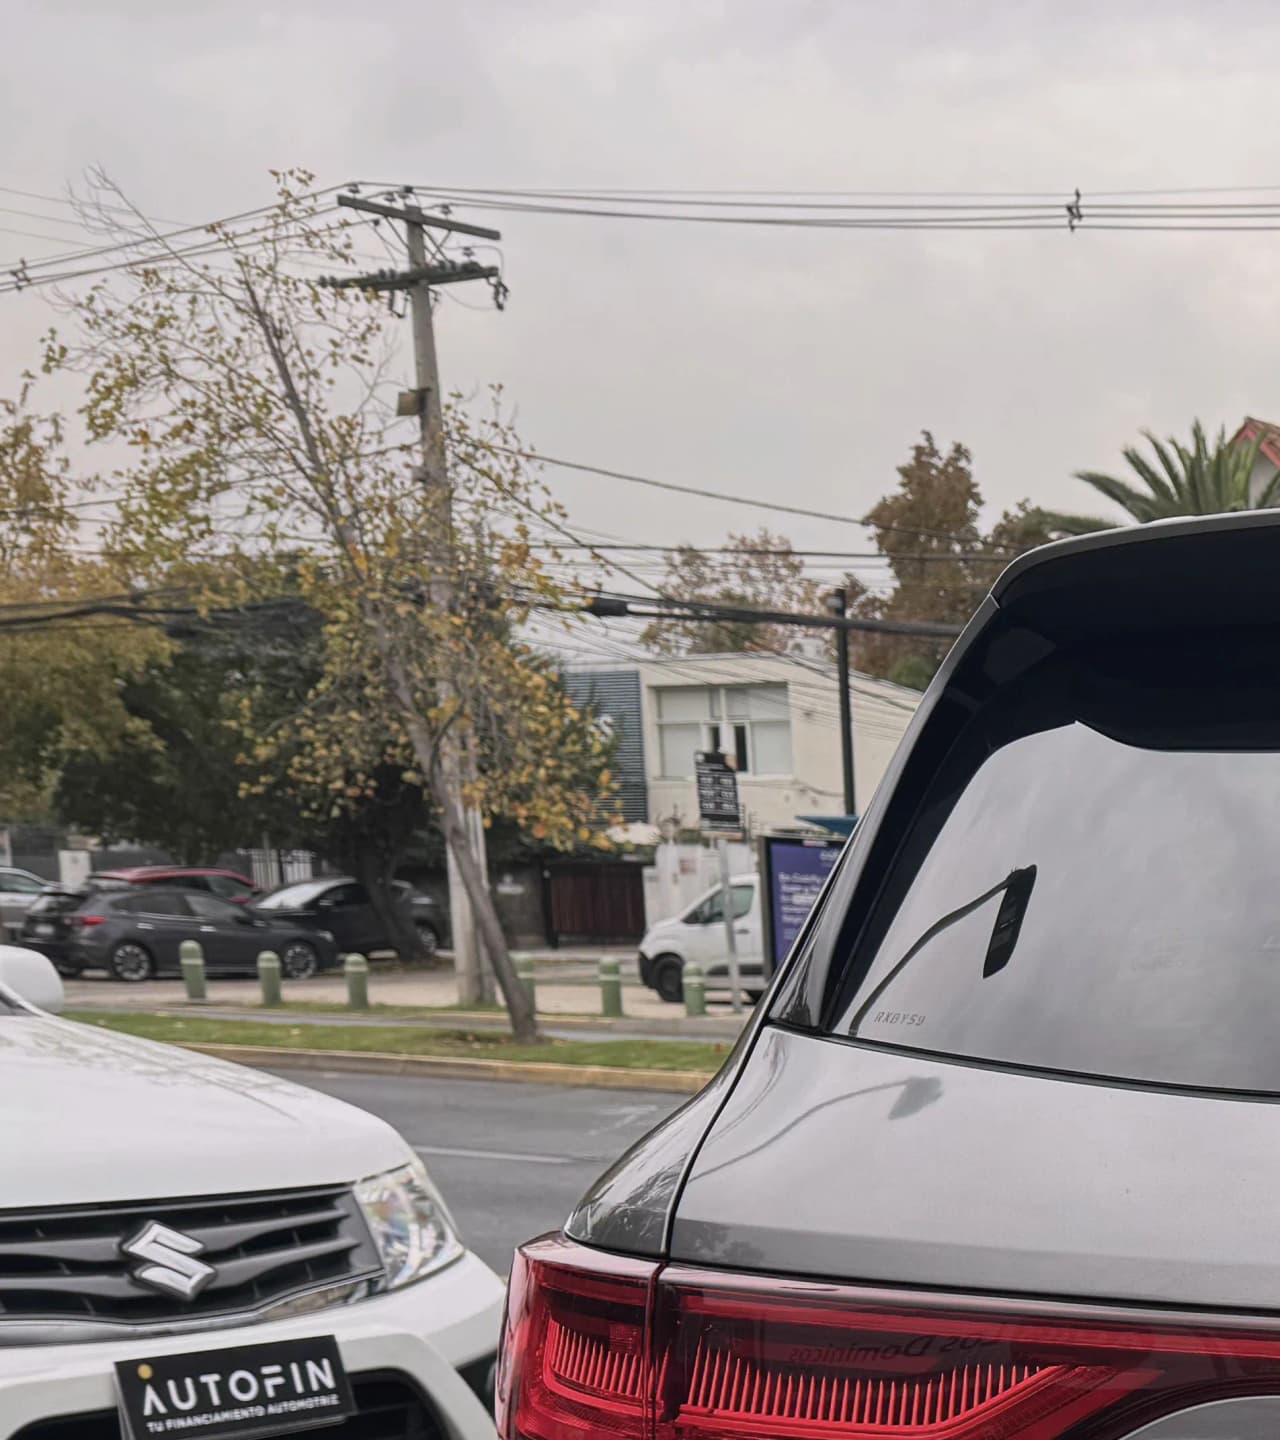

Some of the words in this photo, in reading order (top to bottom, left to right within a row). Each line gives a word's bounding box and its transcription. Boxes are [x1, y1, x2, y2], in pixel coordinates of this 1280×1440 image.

[142, 1357, 337, 1417] AUTOFIN
[146, 1420, 165, 1433] TU
[166, 1404, 265, 1430] FINANCIAMIENTO
[267, 1393, 340, 1415] AUTOMOTRIZ
